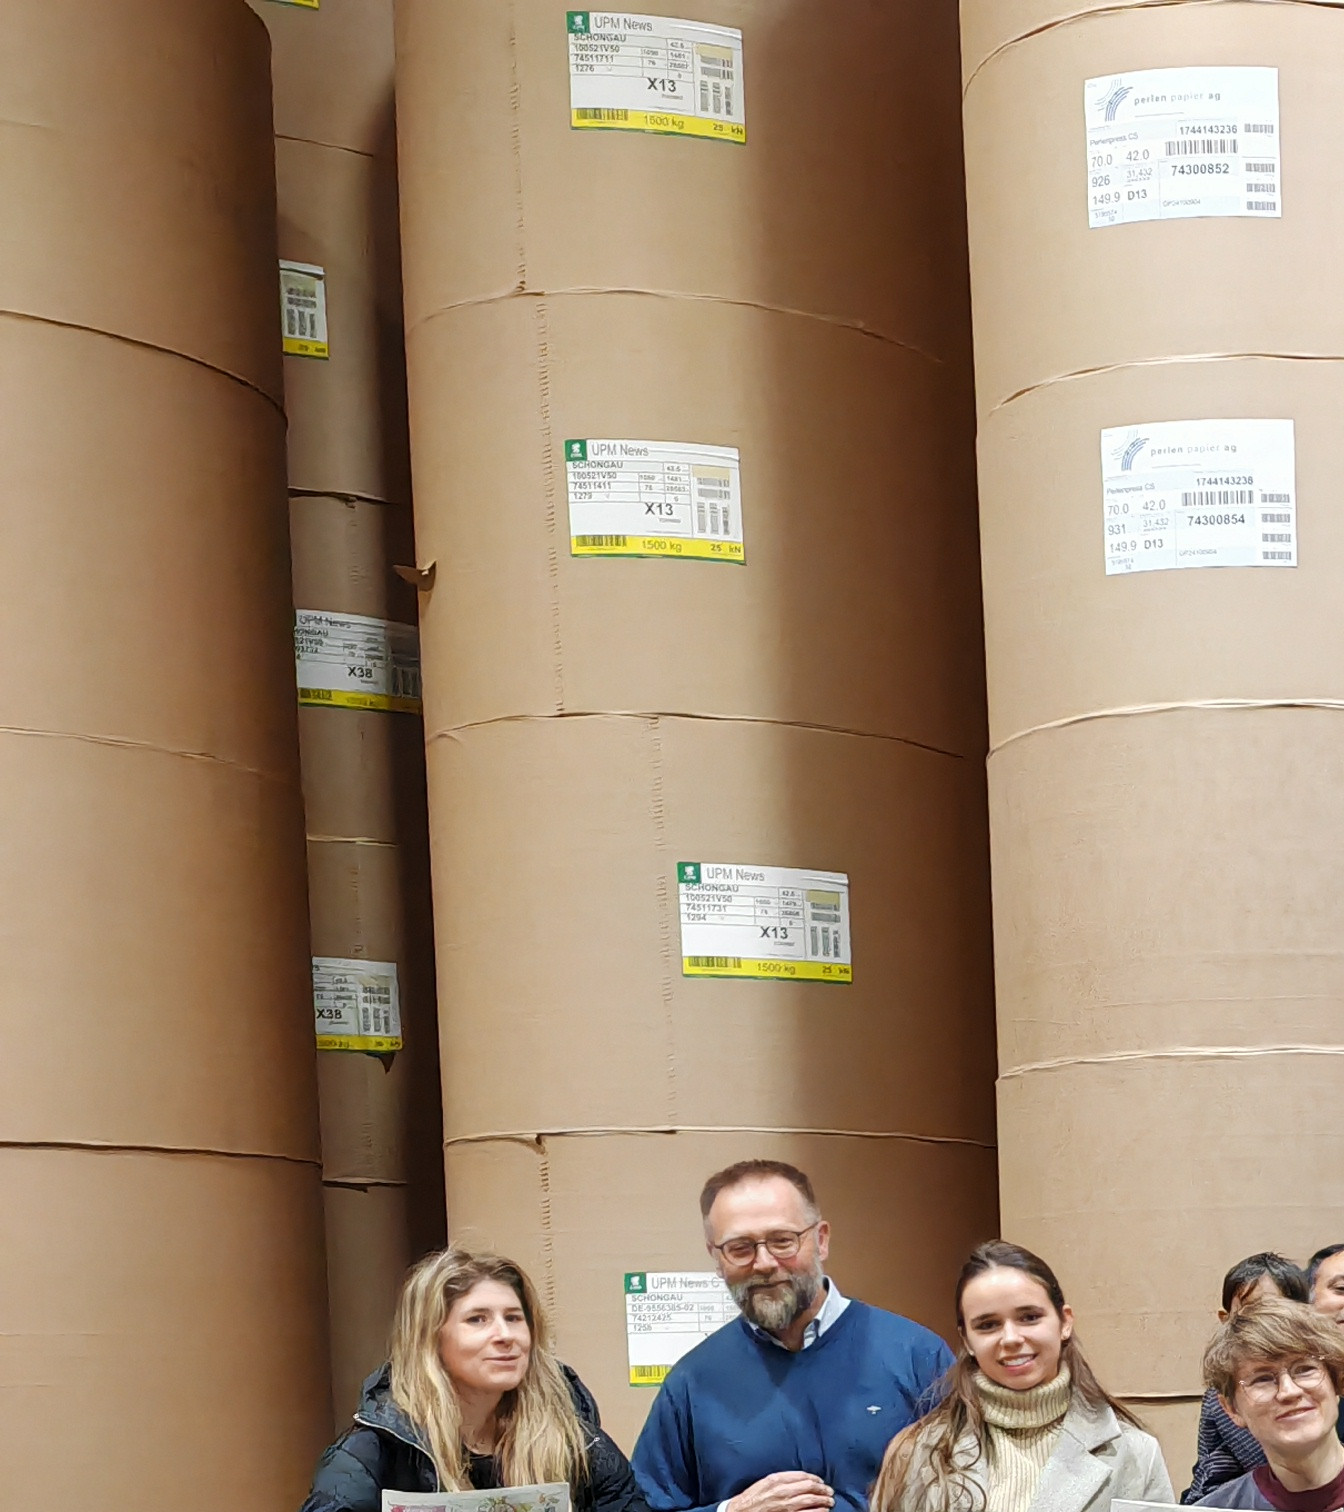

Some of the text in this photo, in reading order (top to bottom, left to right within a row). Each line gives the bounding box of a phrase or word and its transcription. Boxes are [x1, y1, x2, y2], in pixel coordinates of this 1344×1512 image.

[594, 16, 653, 31] UPM News
[647, 78, 676, 92] X13
[1134, 92, 1221, 106] perlen papier ag
[644, 115, 669, 126] 1500
[671, 118, 684, 130] kg
[1091, 149, 1150, 168] 70.0 42.0
[1171, 163, 1229, 176] 74300852
[1092, 190, 1147, 206] 149.9 D13
[592, 443, 649, 457] UPM News
[1150, 444, 1237, 456] perlen papier ag
[645, 503, 673, 516] X13
[1107, 499, 1166, 515] 70.0 42.0
[1187, 514, 1245, 527] 74300854
[643, 540, 666, 550] 1500
[669, 541, 682, 553] kg
[711, 544, 721, 552] 25
[1110, 539, 1163, 553] 149.9 D13
[347, 666, 373, 679] X38
[707, 867, 765, 882] UPM News
[760, 926, 788, 940] X13
[757, 962, 781, 973] 1500
[651, 1277, 676, 1290] UPM
[679, 1277, 708, 1288] News
[632, 1294, 683, 1302] SCHONGAU
